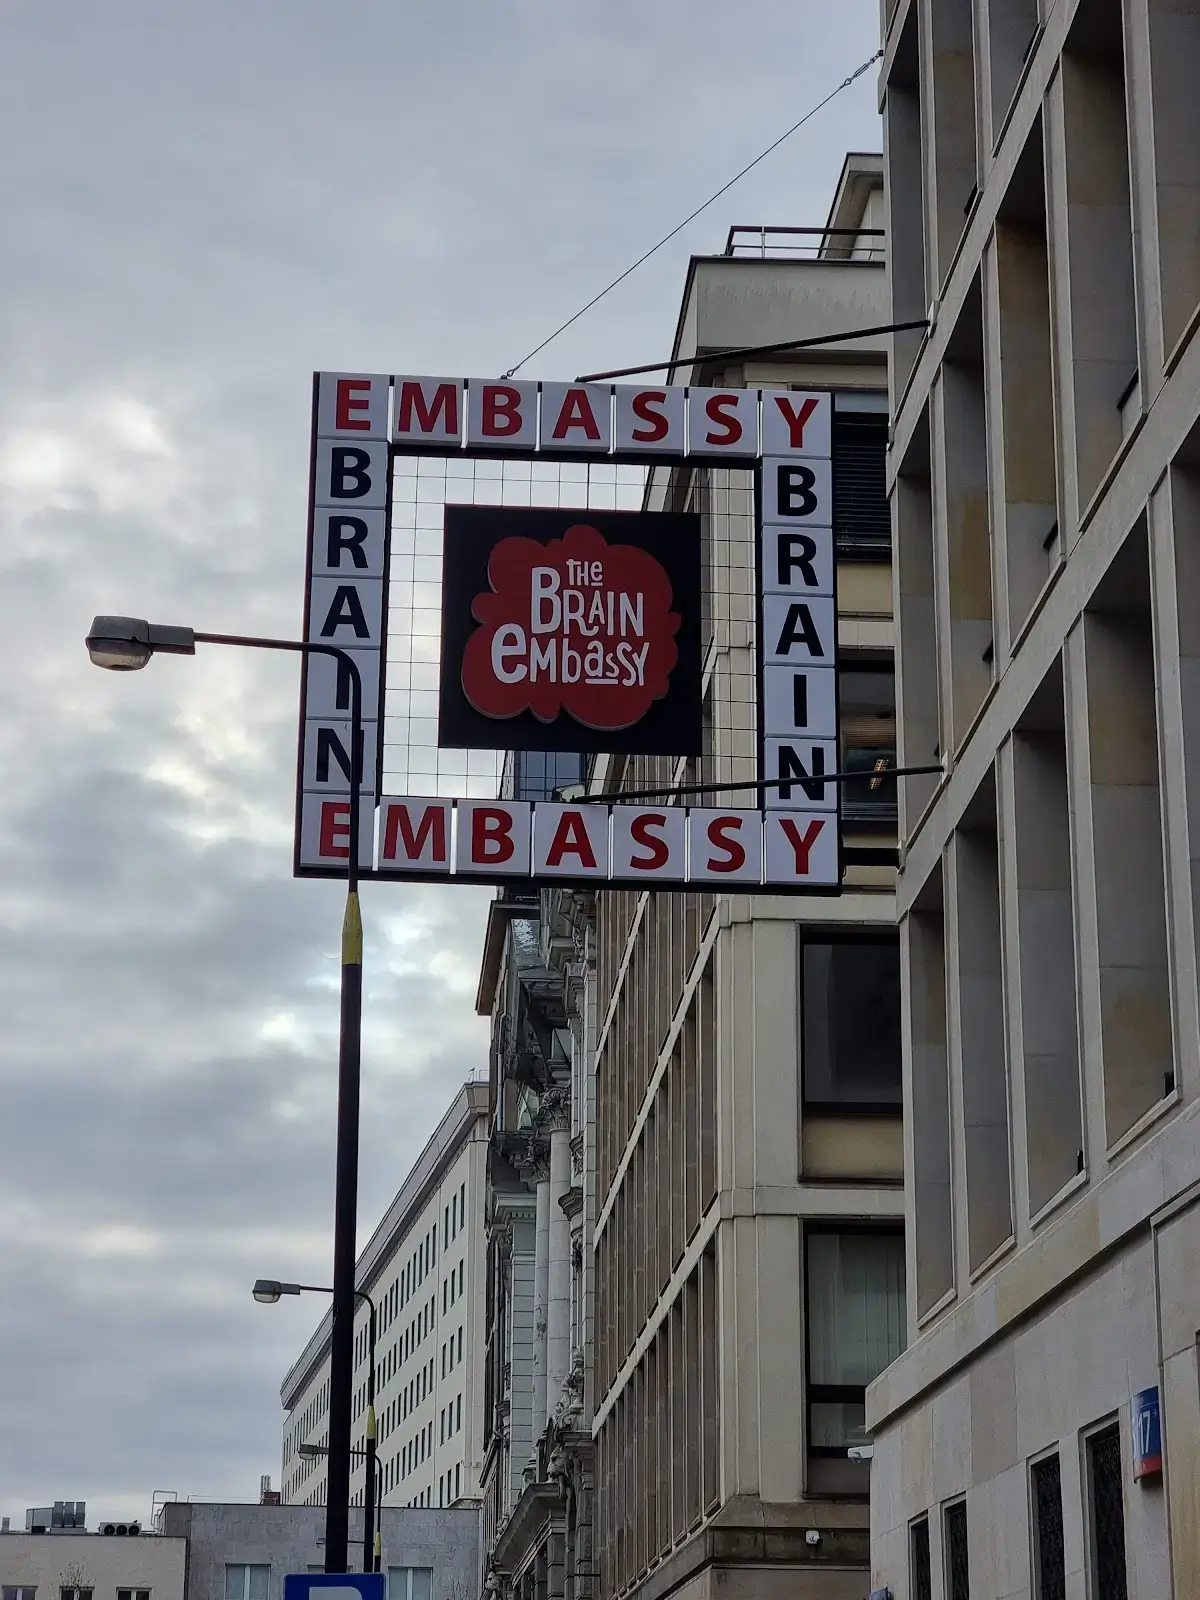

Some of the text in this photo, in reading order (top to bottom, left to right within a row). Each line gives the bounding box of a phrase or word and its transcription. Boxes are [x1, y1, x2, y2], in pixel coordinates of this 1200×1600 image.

[335, 378, 819, 449] EMBASSY
[315, 446, 372, 785] BRAIN
[531, 566, 644, 637] BRAIN
[775, 465, 826, 801] BRAIN
[318, 801, 826, 875] EMBASSY
